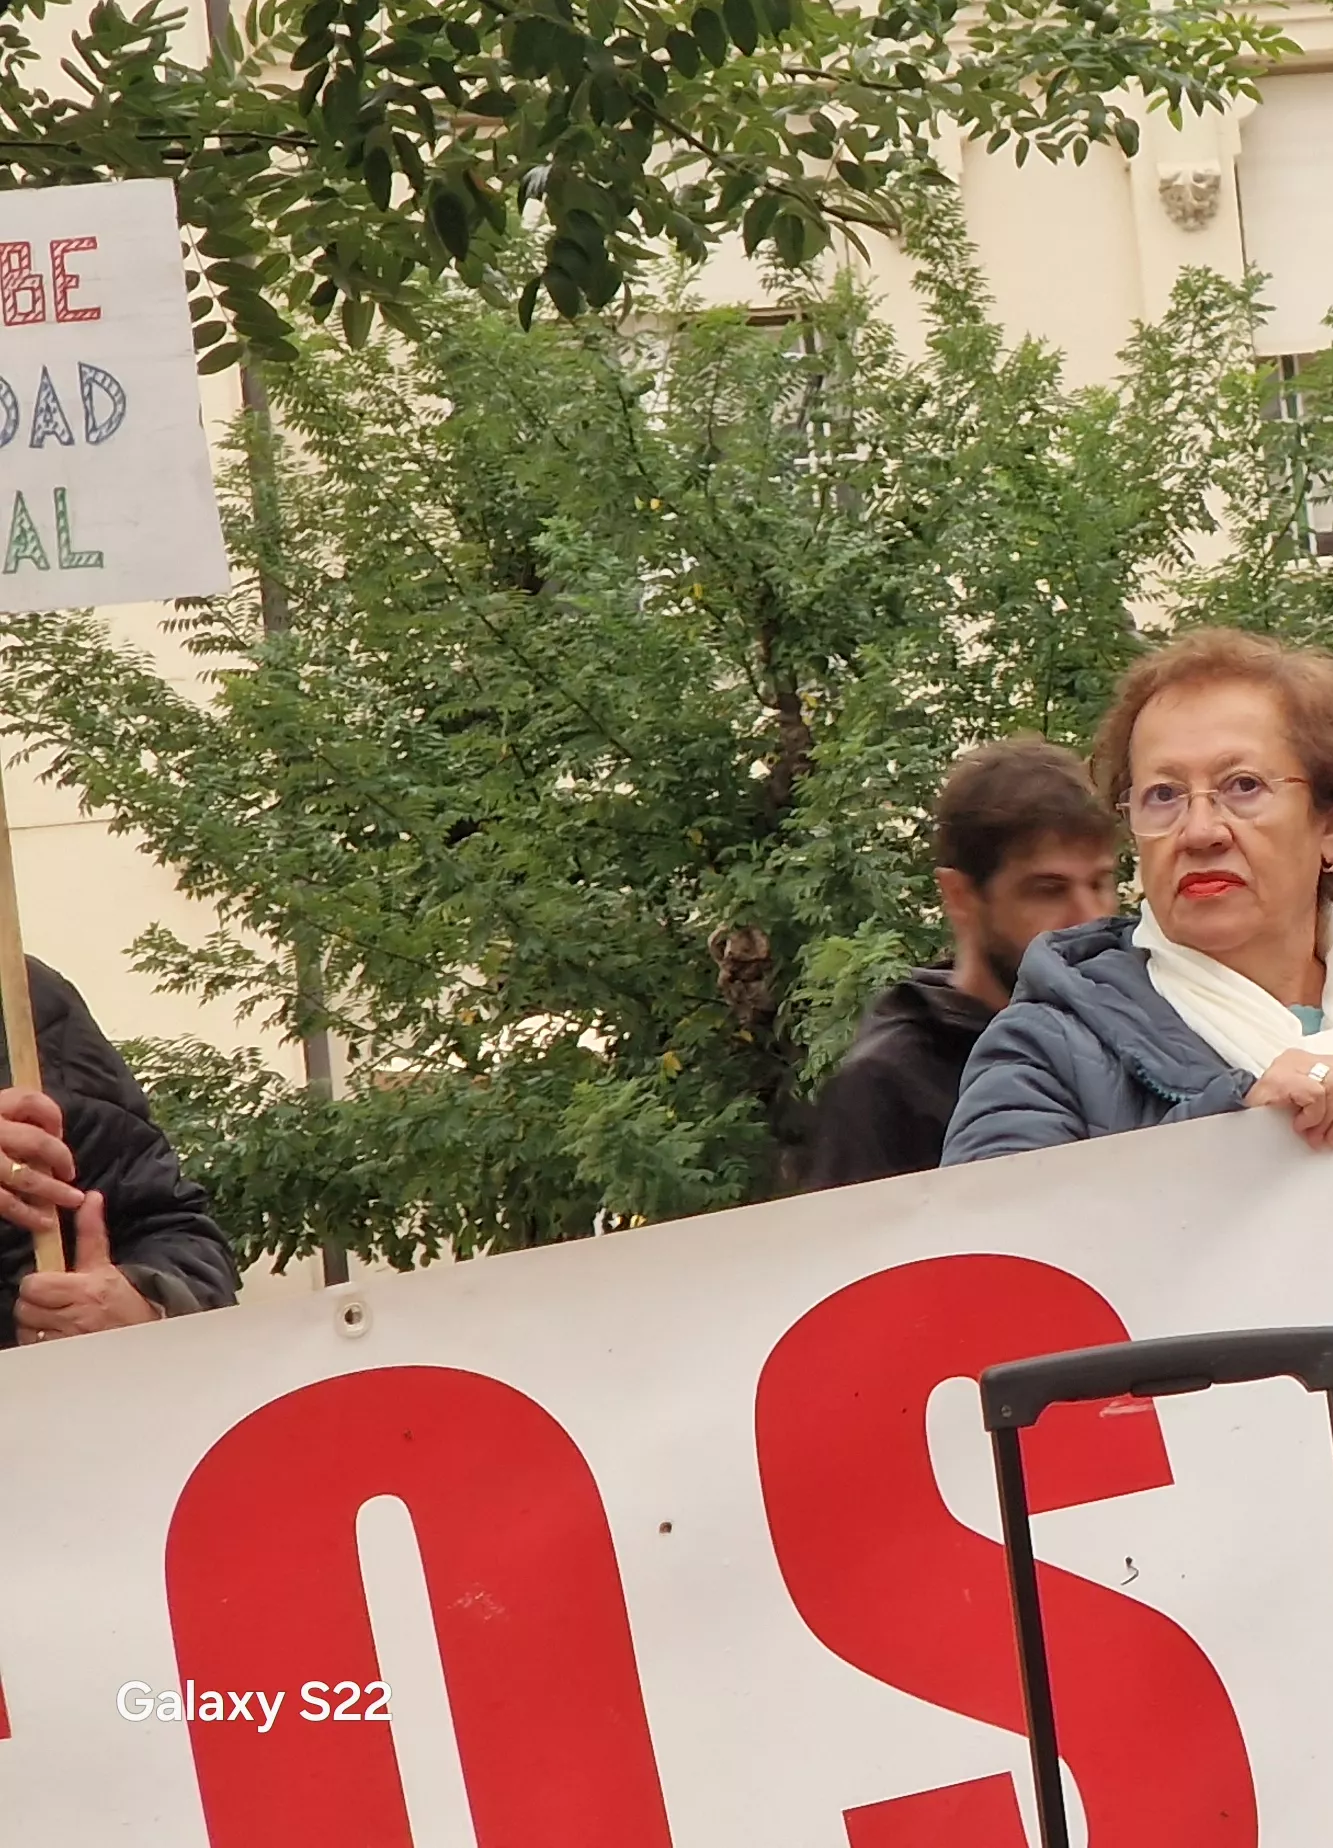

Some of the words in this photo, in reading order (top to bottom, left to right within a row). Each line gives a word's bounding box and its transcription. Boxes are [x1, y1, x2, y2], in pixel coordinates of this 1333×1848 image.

[0, 236, 101, 326] BE
[3, 487, 104, 574] AL
[0, 1253, 1259, 1848] OS
